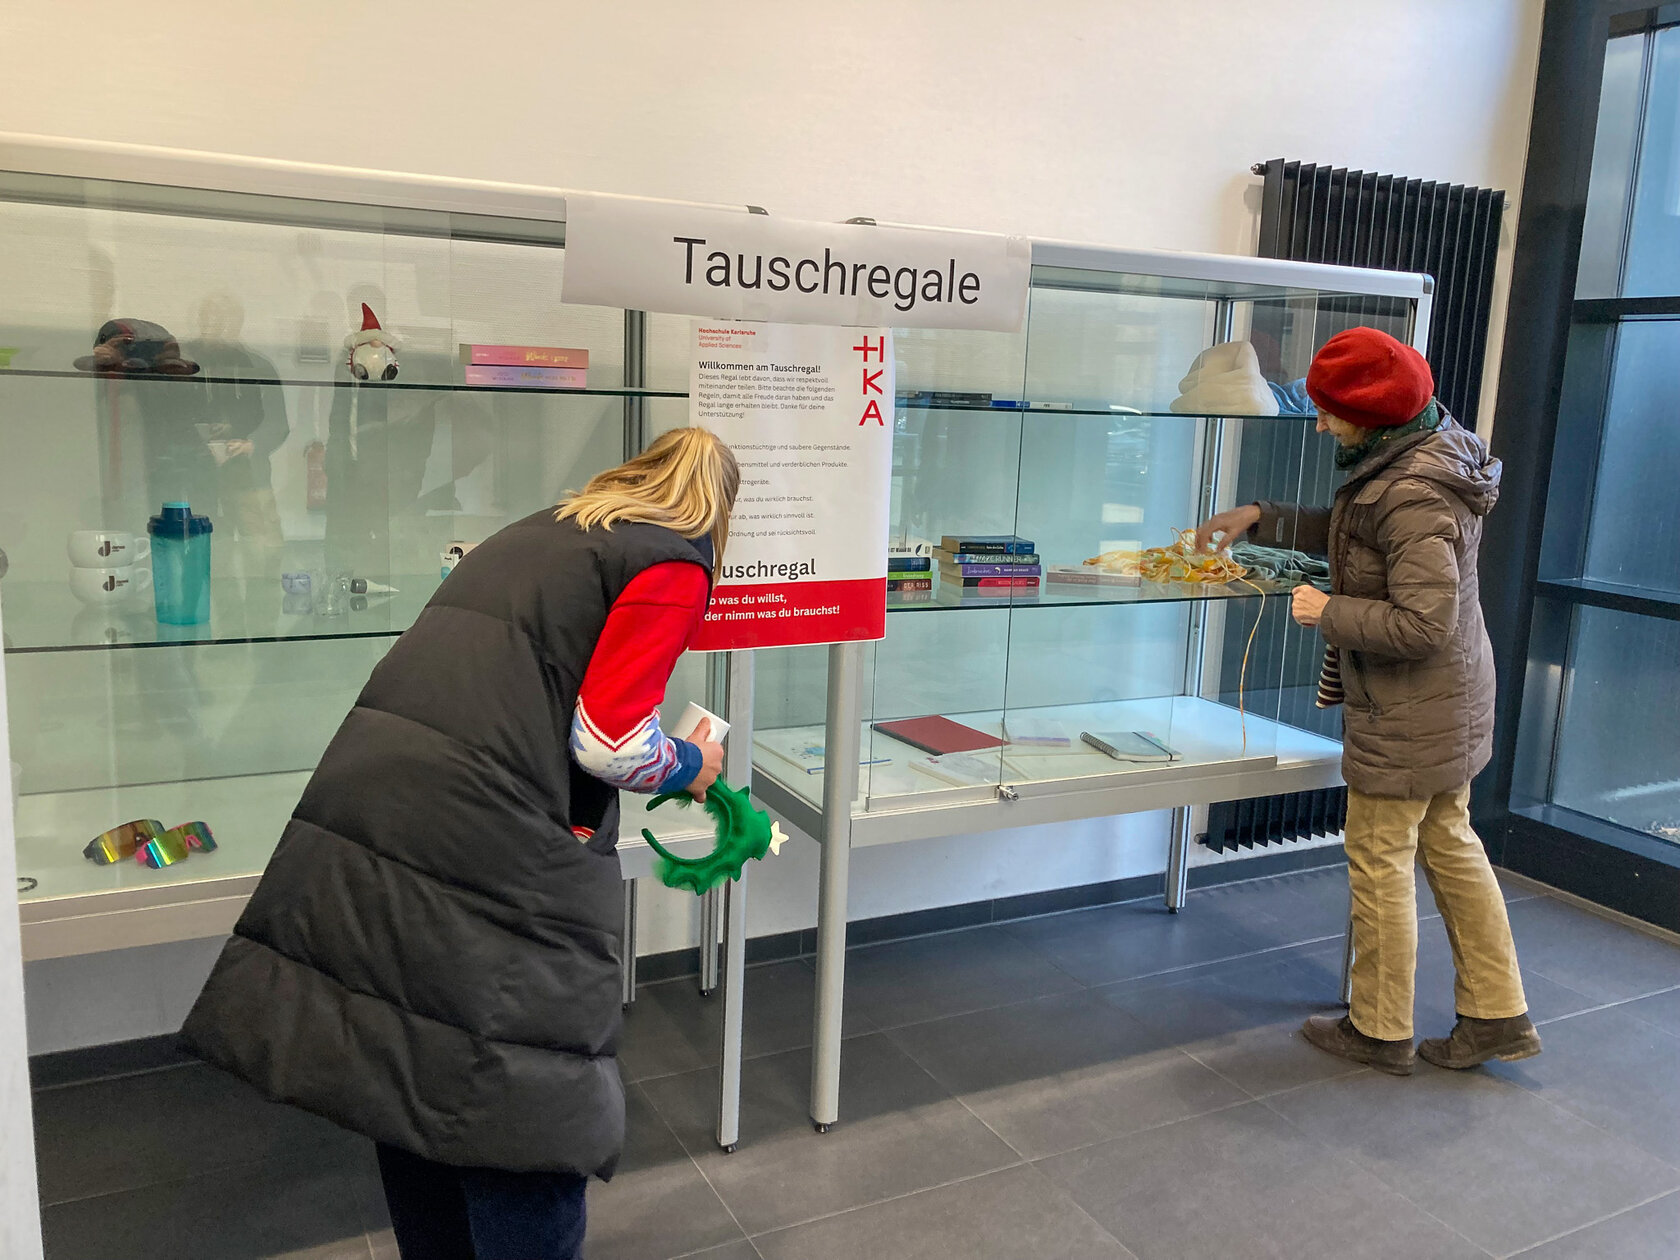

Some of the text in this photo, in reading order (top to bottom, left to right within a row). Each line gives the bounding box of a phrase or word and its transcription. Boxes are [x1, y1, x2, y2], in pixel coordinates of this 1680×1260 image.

[674, 237, 981, 312] Tauschregale
[699, 361, 754, 370] Willkommen
[770, 364, 821, 374] Tauschregal!
[721, 558, 816, 580] uschregal
[741, 595, 755, 604] du
[757, 594, 787, 604] willst,
[704, 612, 723, 621] der
[725, 611, 755, 620] nimm
[778, 608, 791, 617] du
[794, 606, 840, 616] brauchst!
